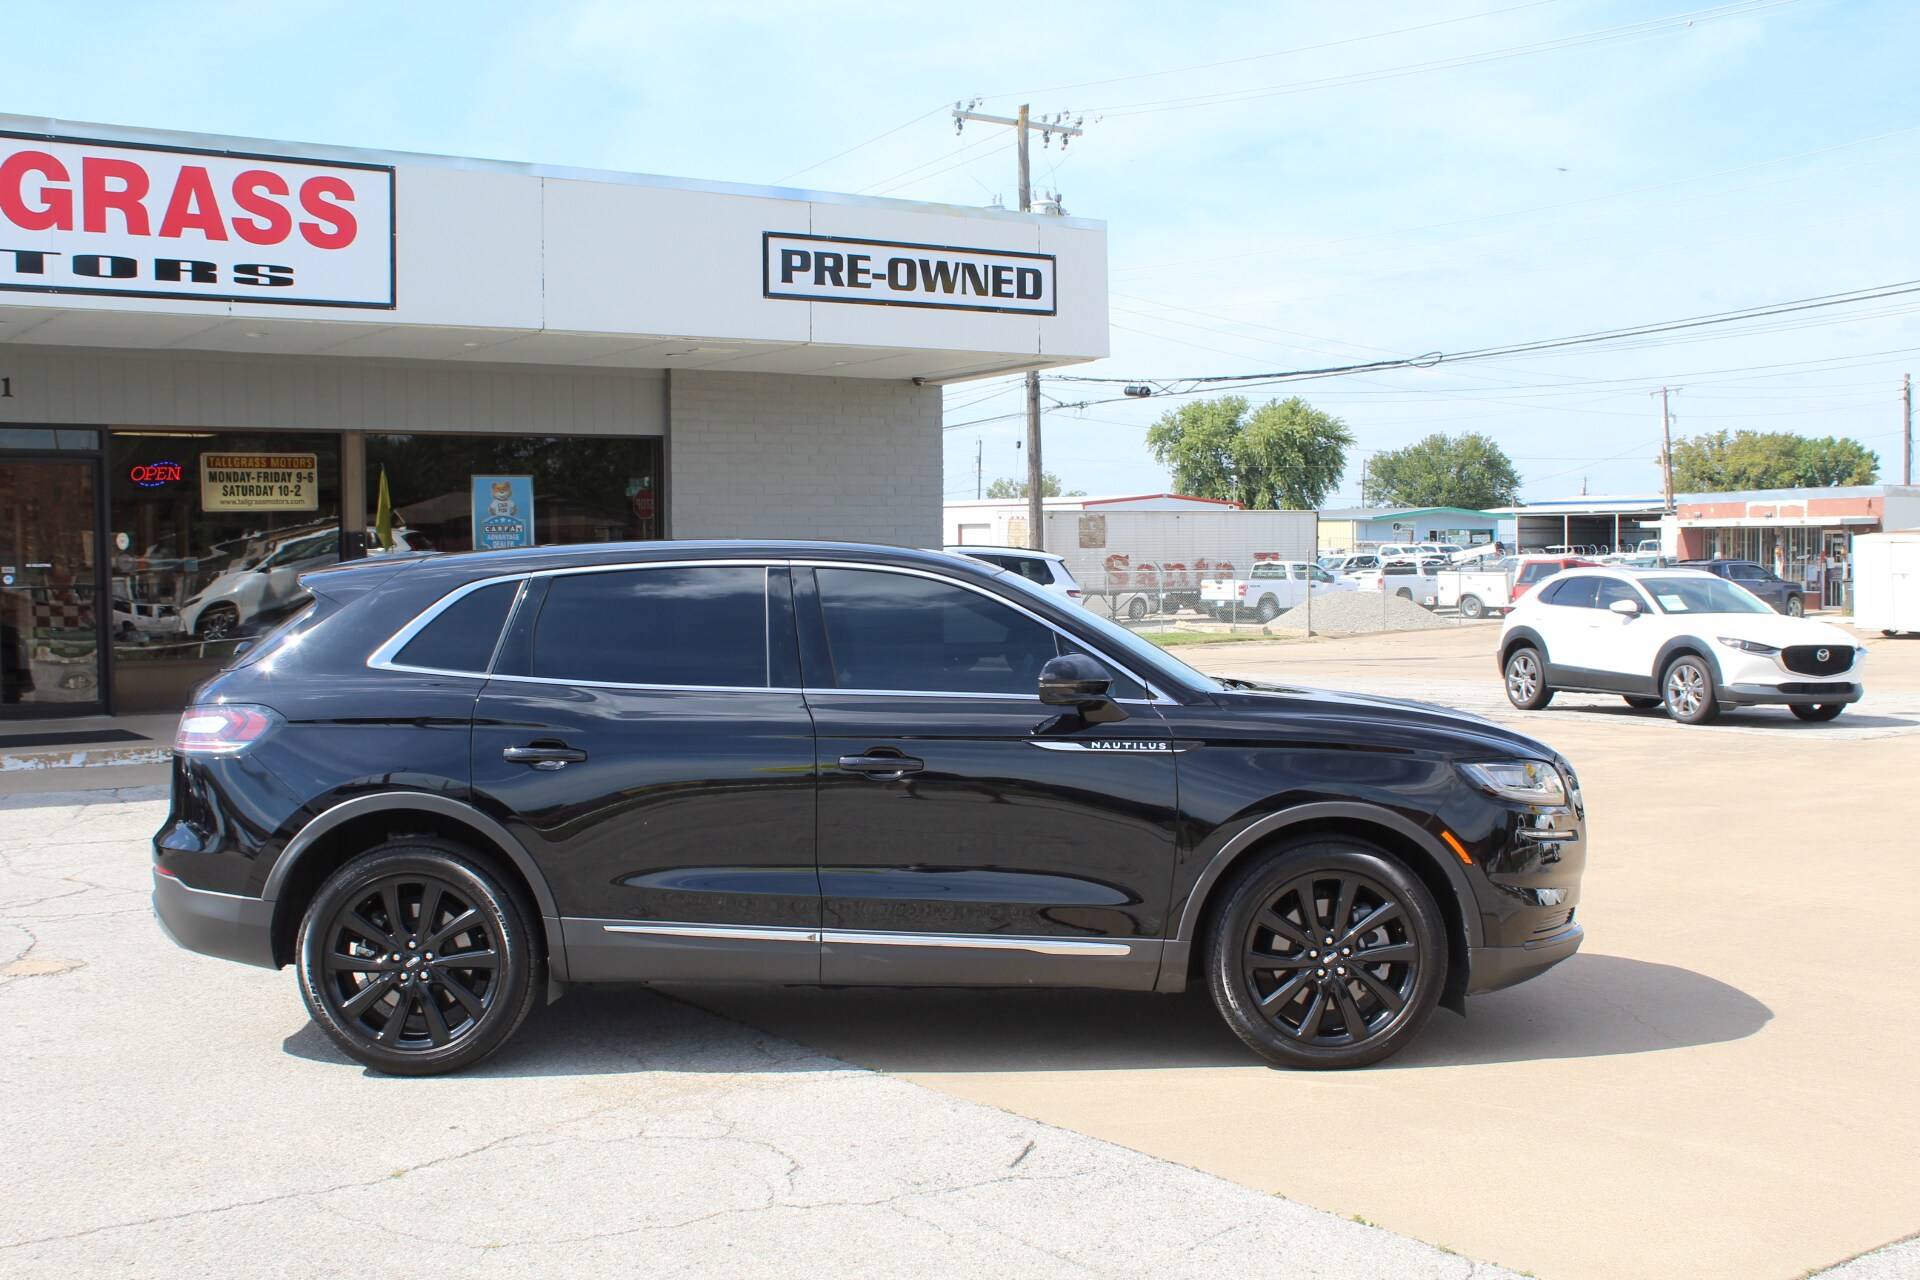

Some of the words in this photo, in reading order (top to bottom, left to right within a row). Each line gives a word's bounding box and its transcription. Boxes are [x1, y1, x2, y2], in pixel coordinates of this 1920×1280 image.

[0, 151, 357, 250] GRASS
[781, 249, 1042, 300] PRE-OWNED
[209, 457, 267, 468] TALLGRASS
[270, 458, 313, 469] MOTORS
[131, 466, 182, 481] OPEN
[208, 471, 293, 483] MONDAY-FRIDAY
[296, 472, 314, 483] 9-6
[222, 485, 275, 497] SATURDAY
[278, 485, 302, 497] 10-2
[1091, 741, 1168, 749] NAUTILUS
